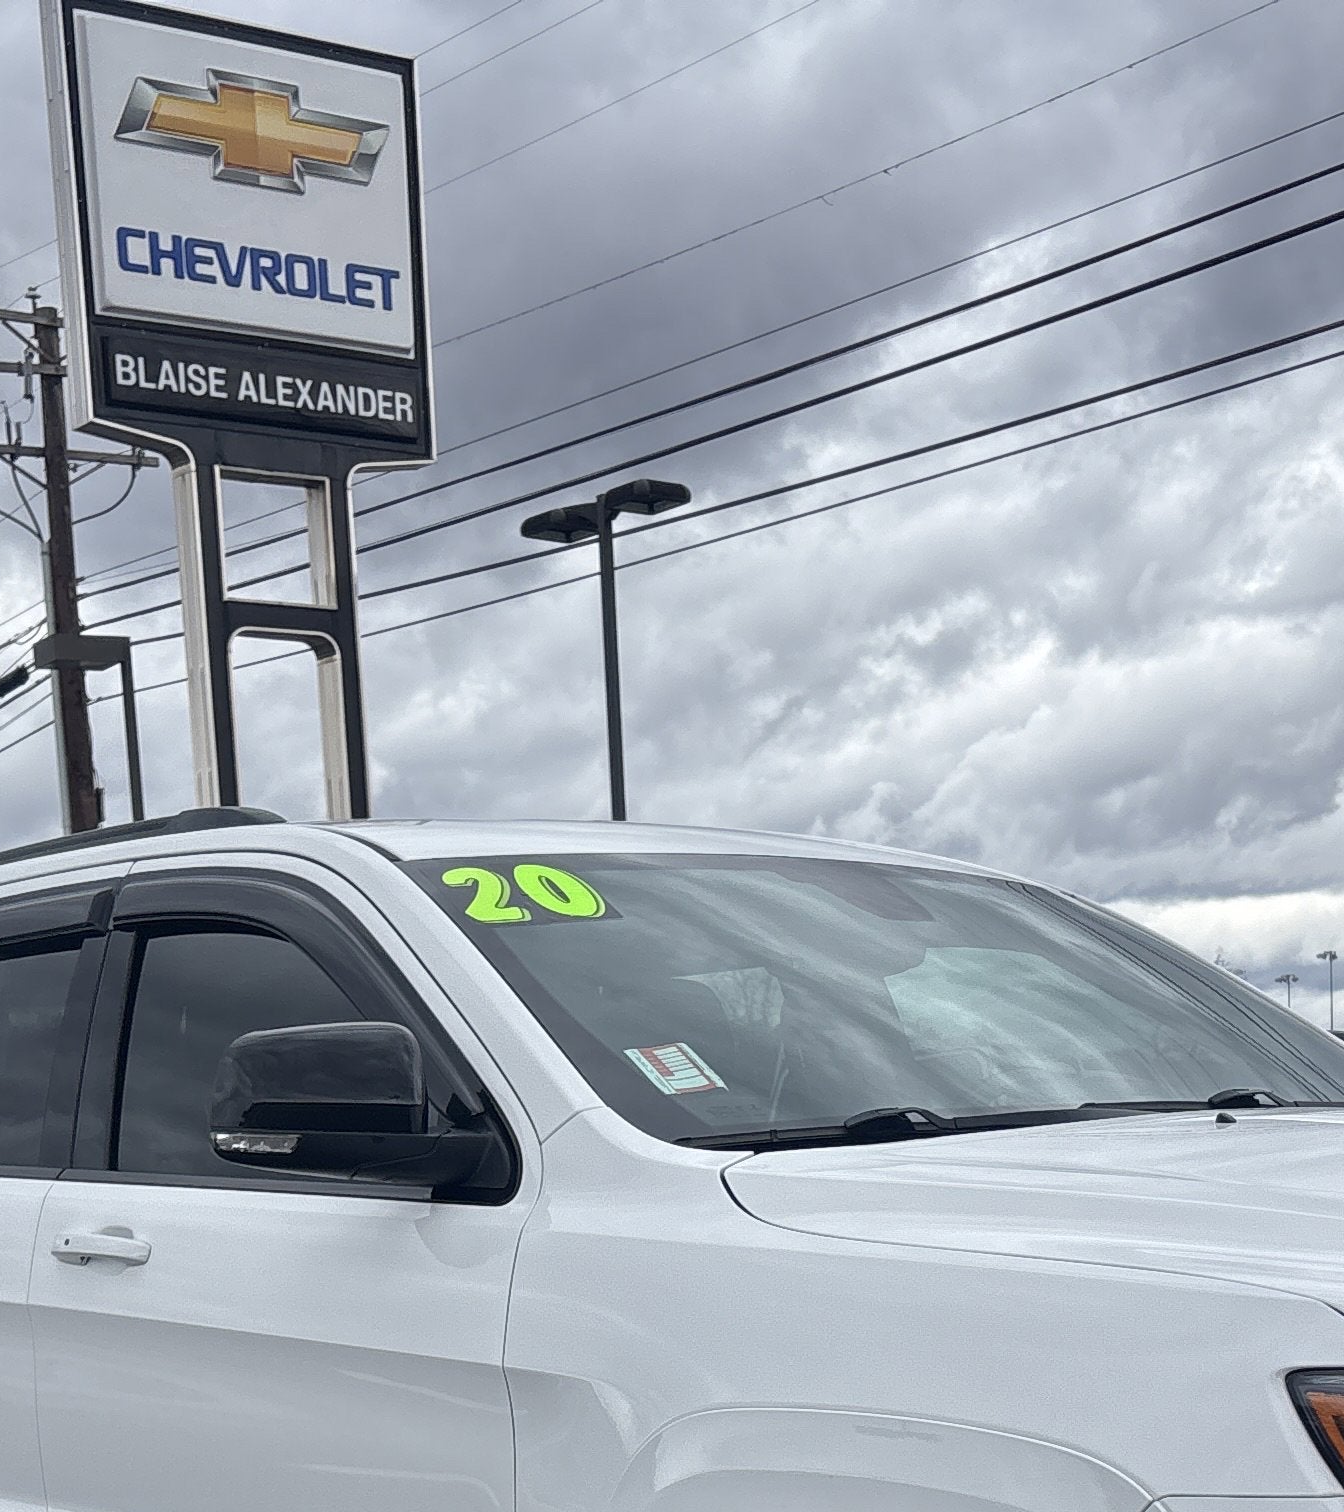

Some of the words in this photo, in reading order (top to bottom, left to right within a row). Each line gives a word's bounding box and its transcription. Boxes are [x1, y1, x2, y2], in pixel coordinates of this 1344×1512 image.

[116, 226, 400, 311] CHEVROLET
[114, 353, 228, 399] BLAISE
[237, 371, 414, 423] ALEXANDER
[442, 864, 606, 924] 20
